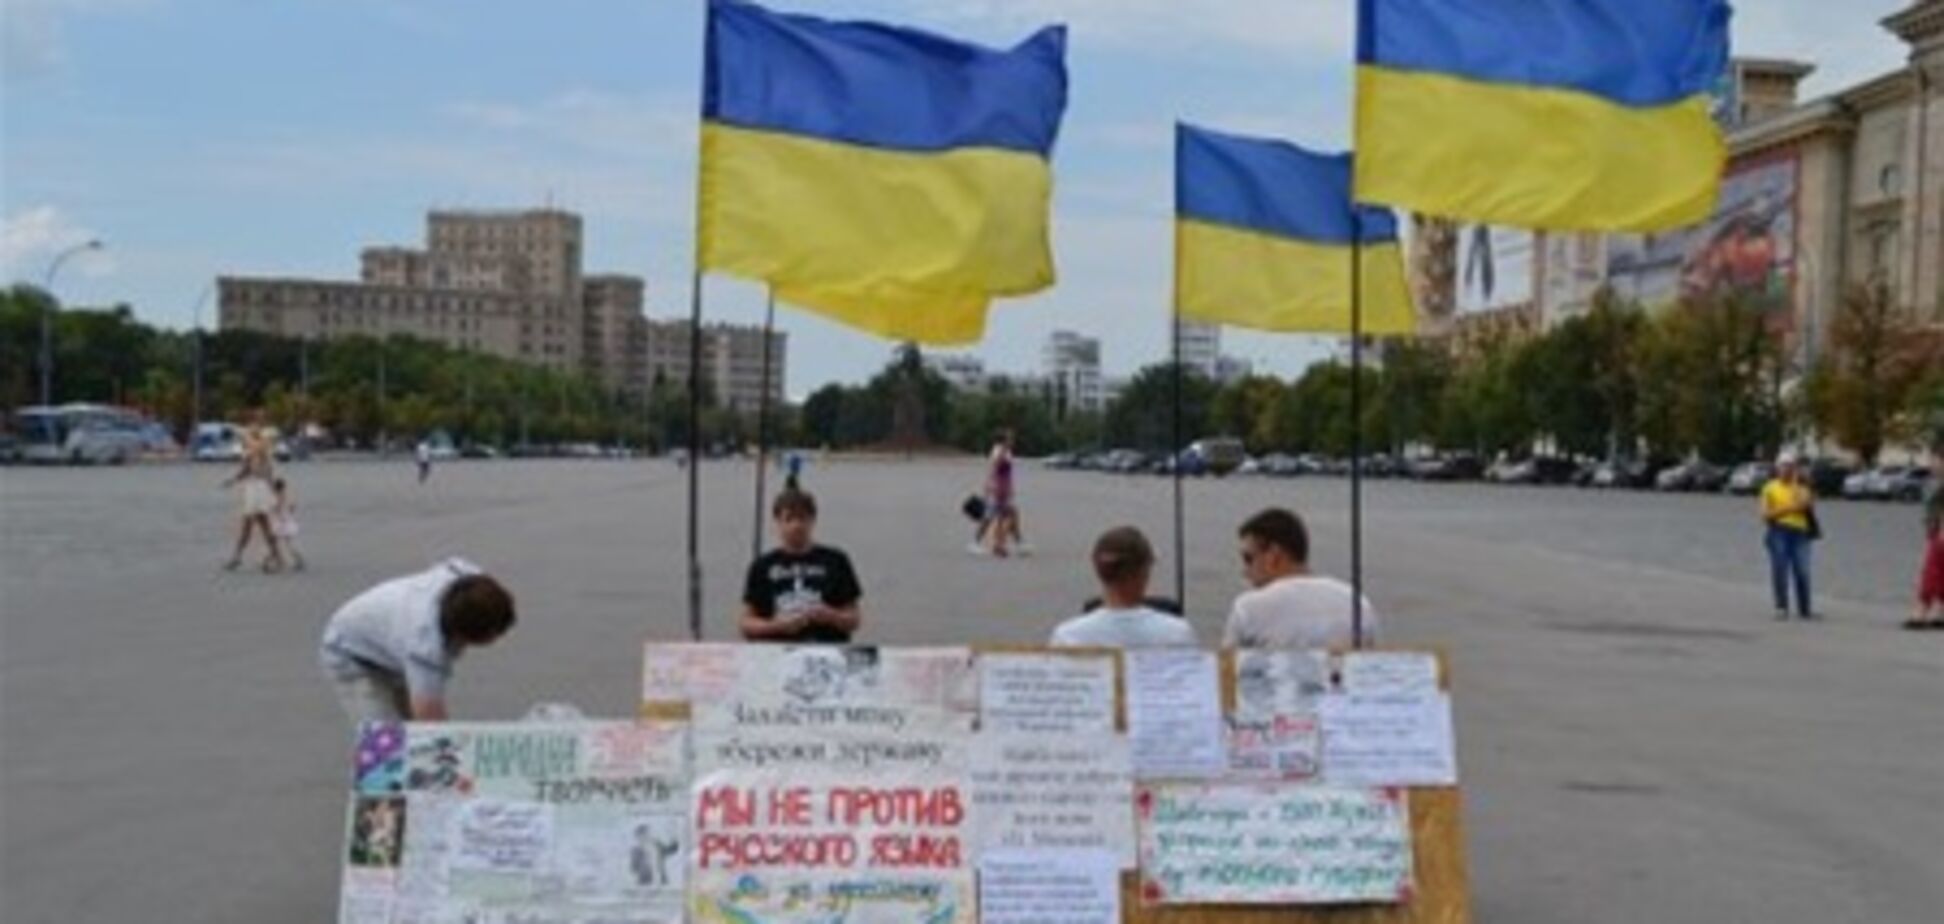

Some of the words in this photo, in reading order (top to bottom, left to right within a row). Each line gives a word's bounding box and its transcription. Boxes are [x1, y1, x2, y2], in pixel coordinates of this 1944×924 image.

[697, 784, 756, 829] МЫ
[767, 786, 812, 826] НЕ
[828, 784, 964, 826] ПРОТИВ
[698, 832, 856, 869] РУССКОГО
[868, 833, 962, 868] ЯЗЫКА
